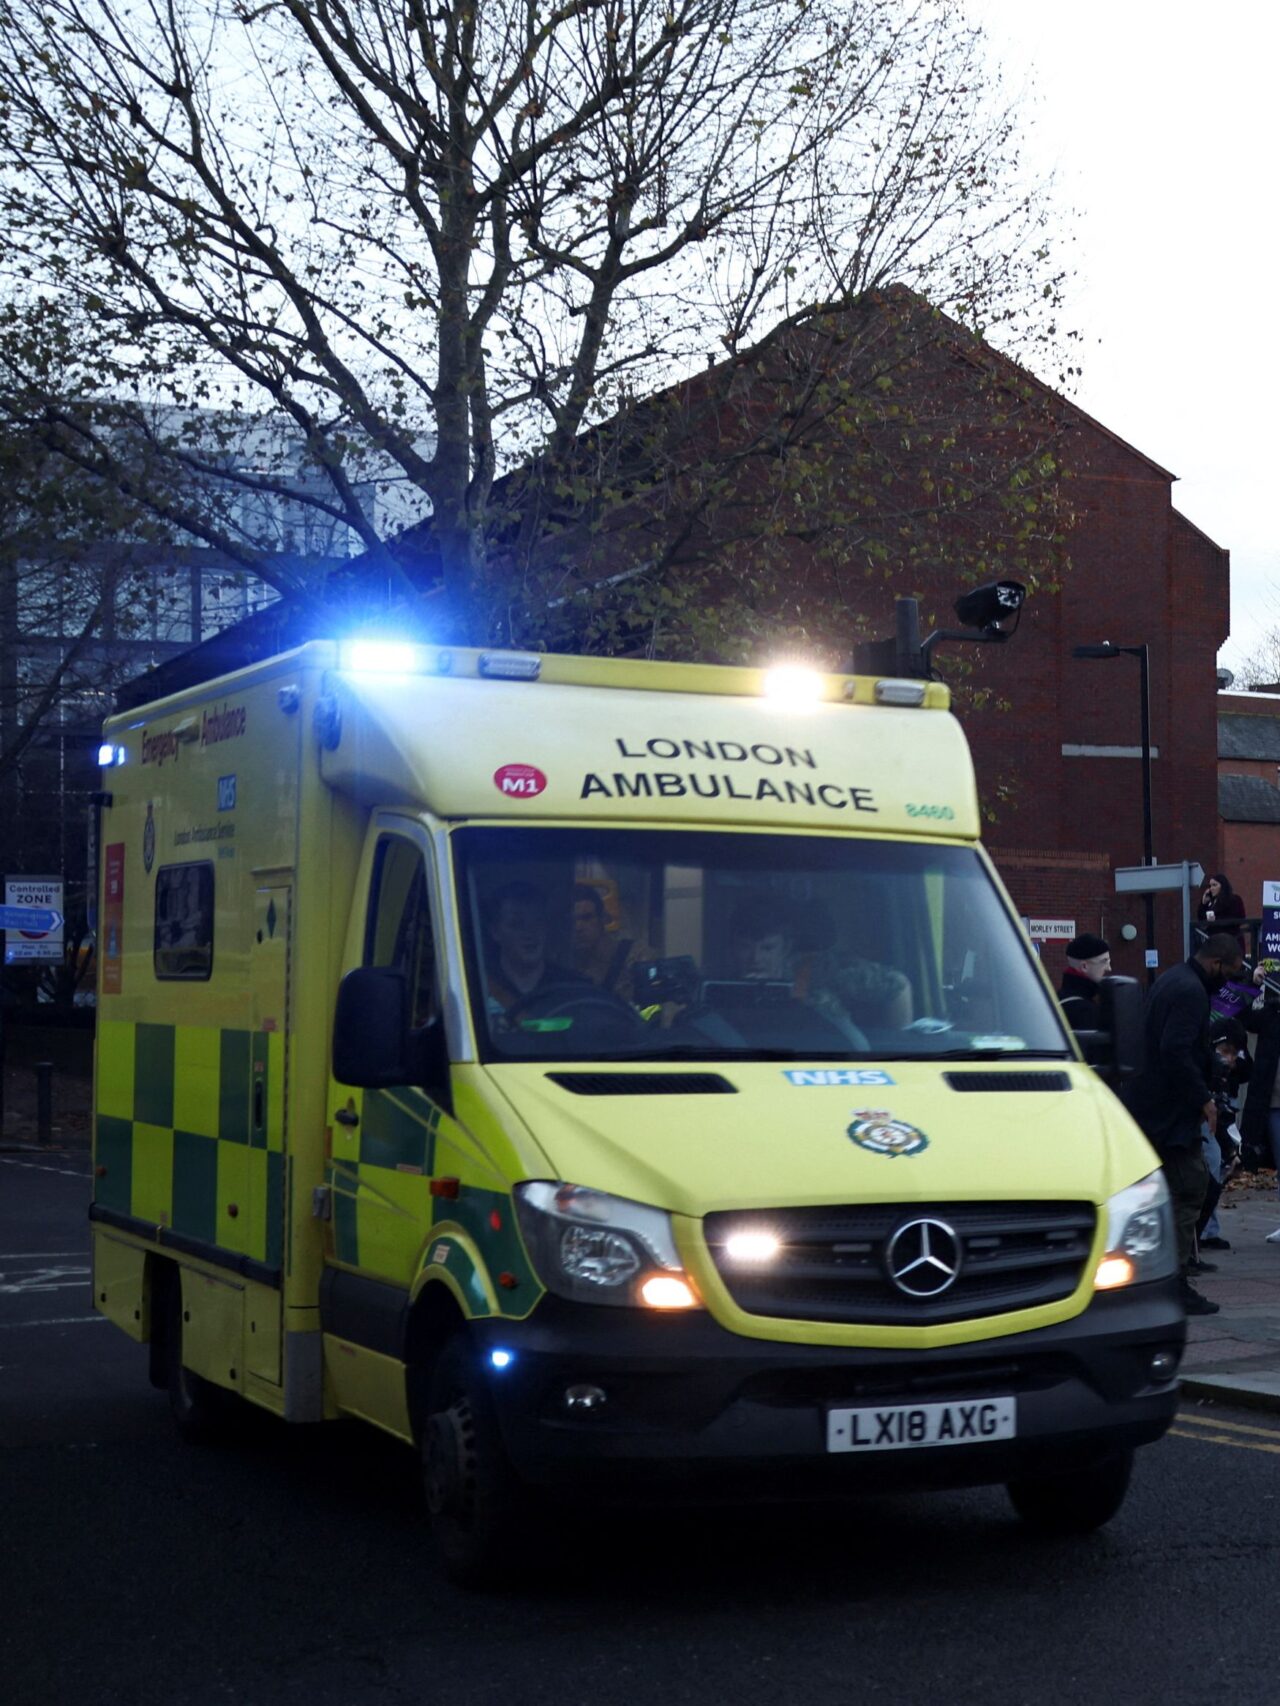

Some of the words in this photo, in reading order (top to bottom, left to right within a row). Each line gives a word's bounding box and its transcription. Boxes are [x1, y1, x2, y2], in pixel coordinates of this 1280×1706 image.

[616, 738, 817, 768] LONDON
[502, 778, 538, 793] M1
[580, 773, 878, 812] AMBULANCE
[10, 884, 60, 893] Controlled
[17, 894, 51, 904] ZONE
[1031, 924, 1052, 934] MORLEY
[1053, 925, 1074, 934] STREET
[791, 1071, 889, 1085] NHS
[852, 1411, 926, 1445] LX18
[938, 1404, 998, 1440] AXG
